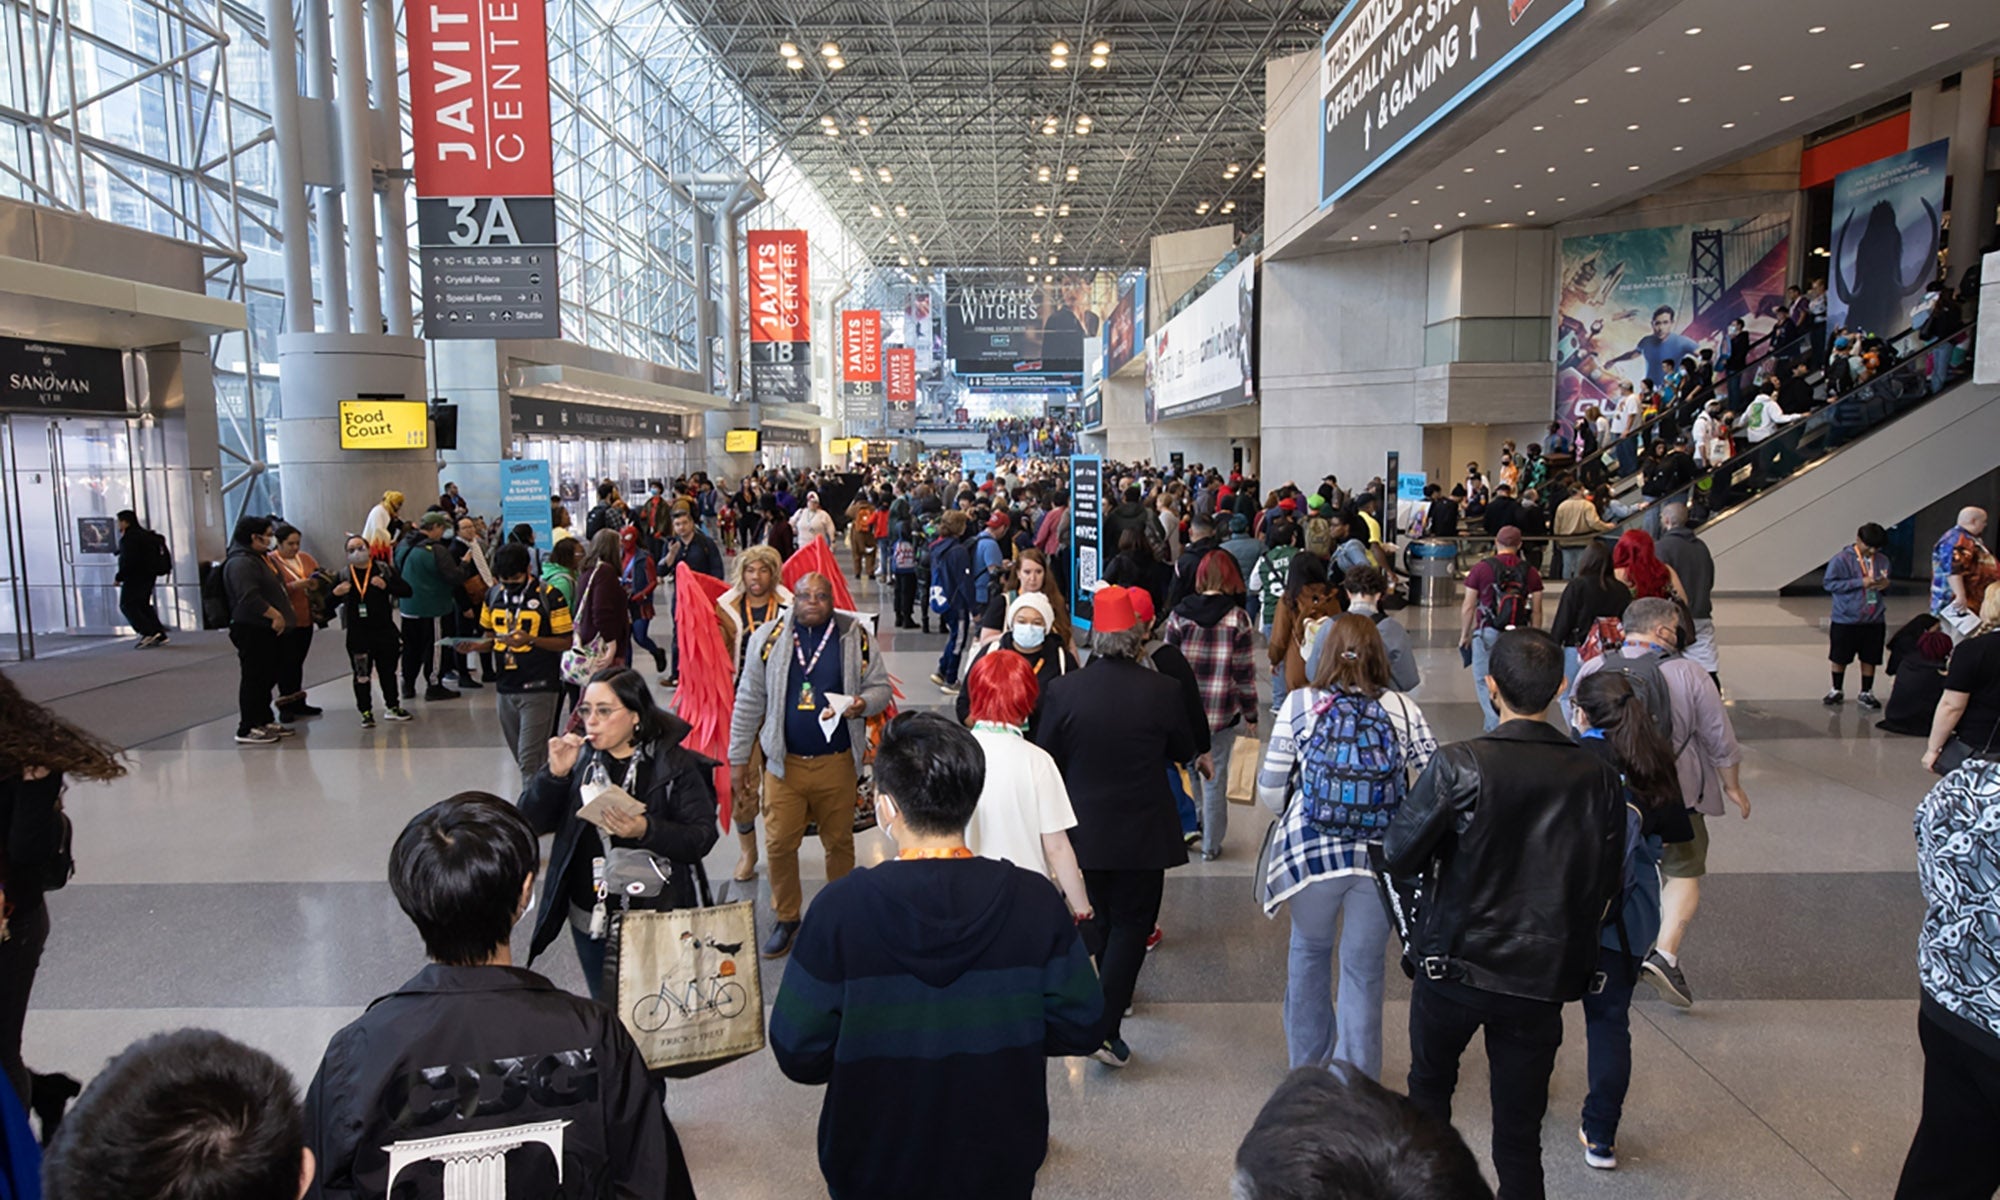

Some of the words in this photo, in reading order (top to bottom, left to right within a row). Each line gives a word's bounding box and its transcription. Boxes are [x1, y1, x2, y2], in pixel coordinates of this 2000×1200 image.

[1326, 53, 1380, 133] OFFICIAL
[1380, 4, 1423, 80] NYCC
[1328, 34, 1351, 84] THIS
[1377, 91, 1389, 130] &
[1389, 24, 1459, 118] GAMING
[447, 196, 522, 246] 3A
[444, 275, 473, 285] Crystal
[474, 275, 500, 284] Palace
[758, 244, 779, 327] JAVITS
[783, 243, 799, 327] CENTER
[1619, 281, 1665, 291] REMAKE
[1666, 276, 1715, 287] HISTORY
[1645, 274, 1671, 282] TIME
[1673, 272, 1688, 280] TO
[446, 294, 474, 303] Special
[476, 293, 502, 302] Events
[960, 286, 1034, 304] MAYFAIR
[515, 310, 543, 320] Shuttle
[960, 303, 1038, 325] WITCHES
[766, 341, 794, 363] 1B
[848, 319, 862, 373] JAVITS
[864, 318, 876, 373] CENTER
[890, 354, 901, 395] JAVITS
[853, 381, 873, 395] 3B
[344, 409, 385, 425] Food
[346, 423, 393, 438] Court
[660, 1035, 690, 1047] TRICK
[699, 1028, 726, 1041] TREAT
[383, 1046, 599, 1129] CDG
